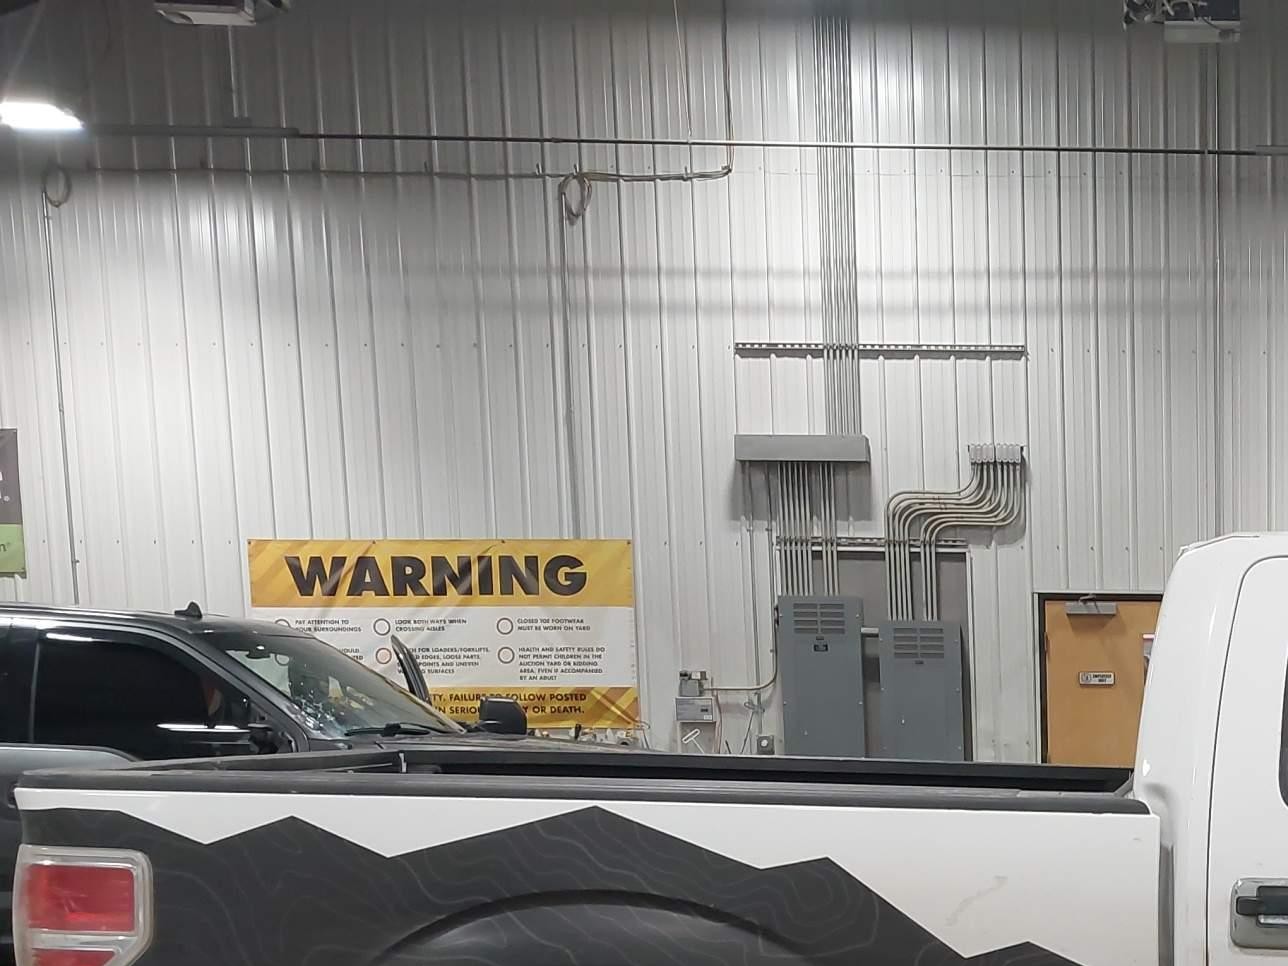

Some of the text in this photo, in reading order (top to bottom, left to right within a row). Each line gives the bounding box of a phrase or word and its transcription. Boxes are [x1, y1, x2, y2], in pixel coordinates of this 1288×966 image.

[285, 555, 587, 597] WARNING
[550, 693, 587, 702] POSTED
[449, 706, 480, 714] SERIO
[532, 706, 546, 714] OR
[550, 706, 585, 714] DEATH.
